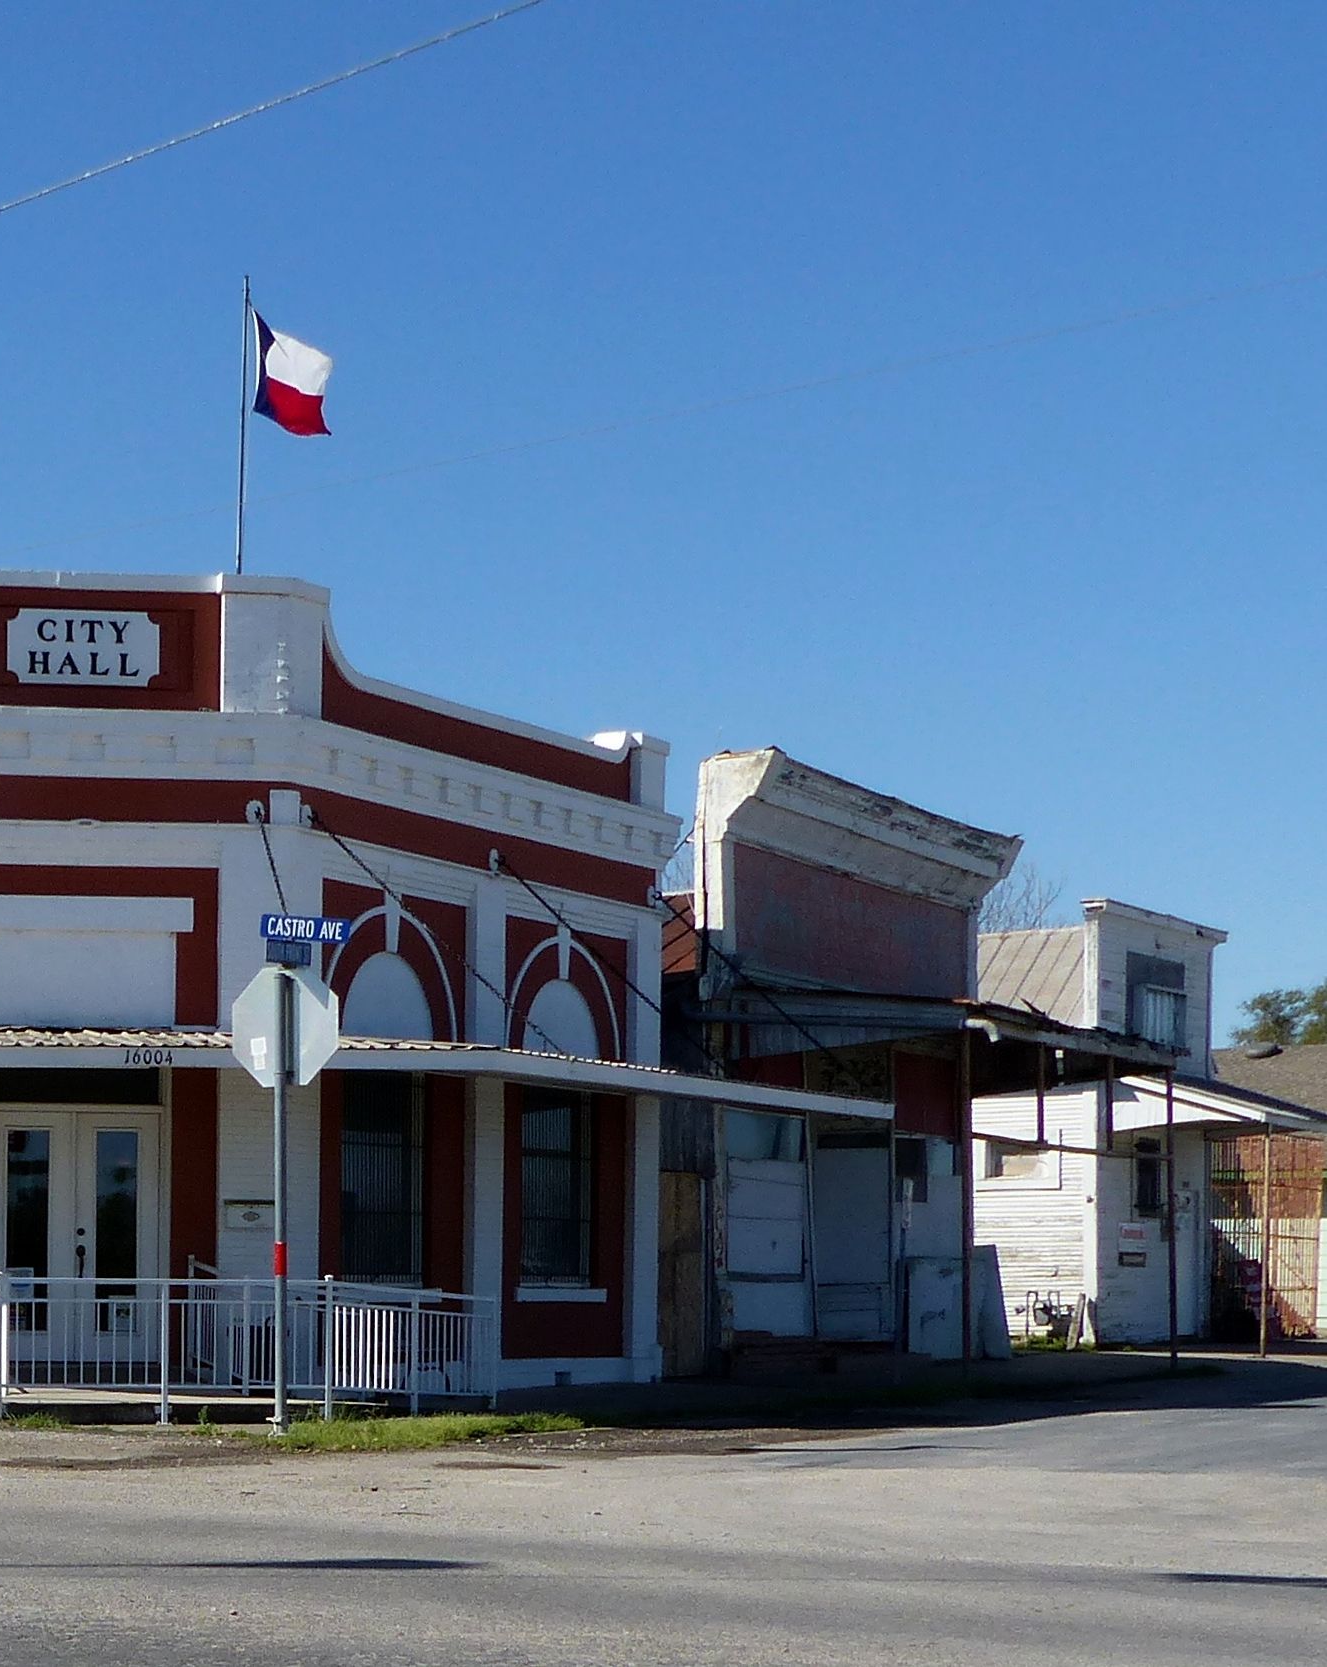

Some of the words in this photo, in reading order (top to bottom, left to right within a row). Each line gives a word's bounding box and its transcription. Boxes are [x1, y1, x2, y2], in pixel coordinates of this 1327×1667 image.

[37, 619, 130, 644] CITY
[28, 651, 140, 677] HALL
[267, 917, 314, 938] CASTRO
[319, 921, 343, 940] AVE
[124, 1047, 173, 1065] 16004
